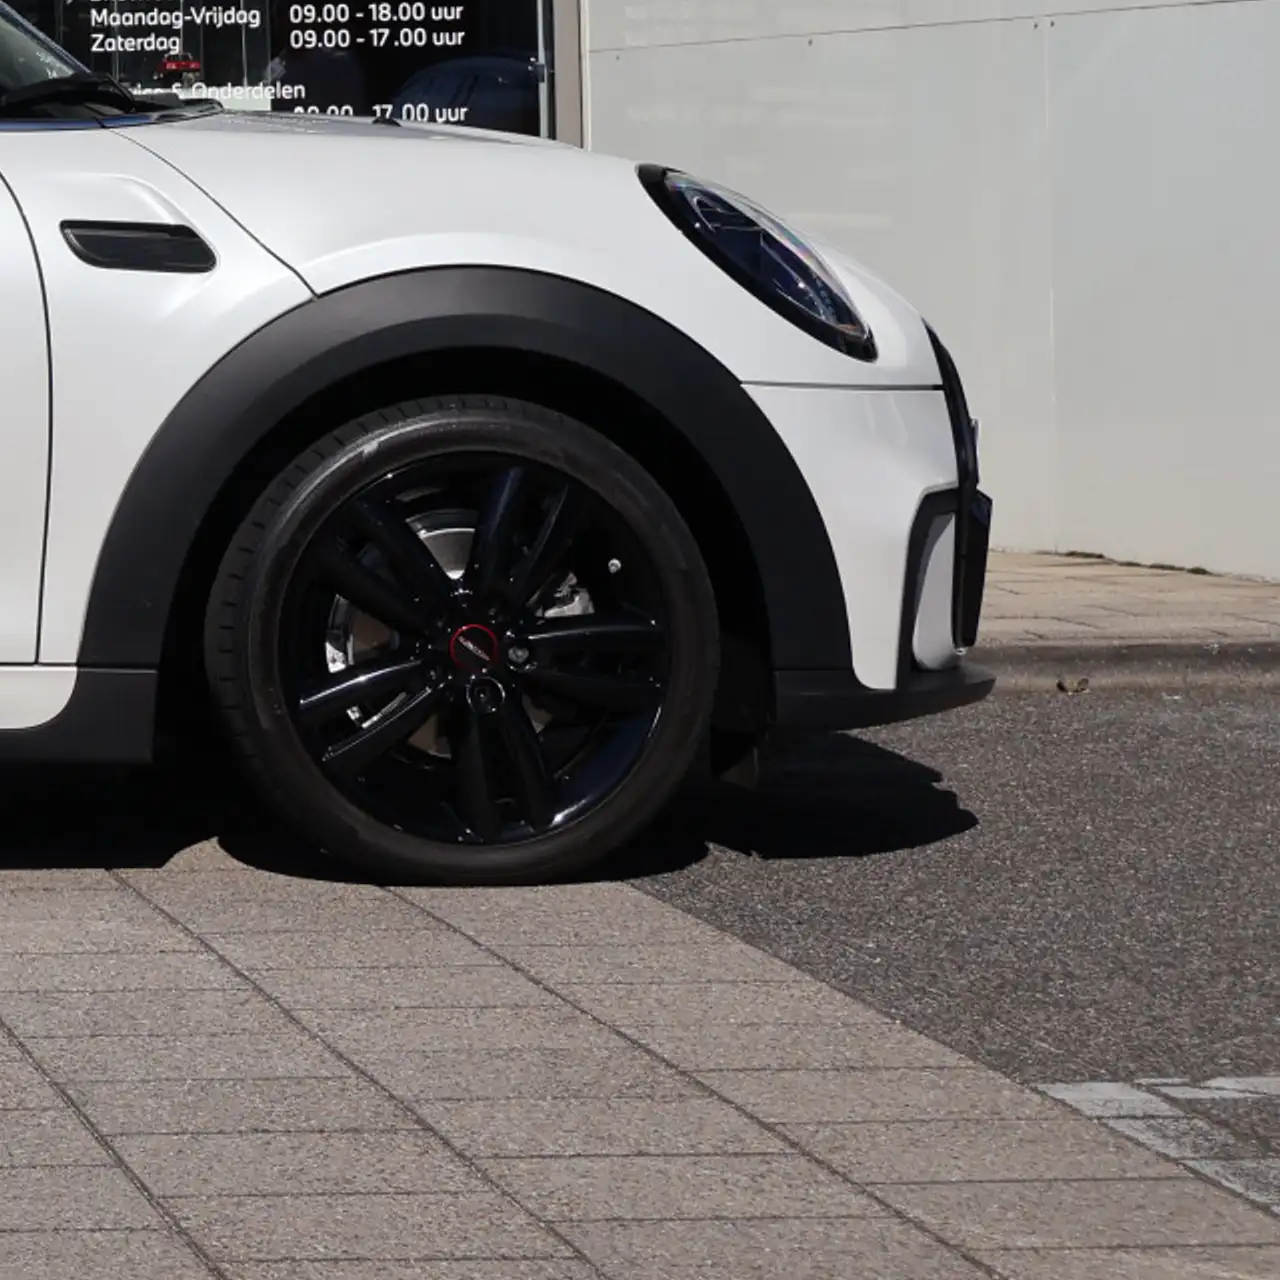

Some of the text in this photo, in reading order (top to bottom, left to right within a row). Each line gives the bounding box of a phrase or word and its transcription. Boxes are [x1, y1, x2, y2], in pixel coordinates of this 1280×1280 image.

[90, 6, 261, 29] Maandag-Vrijdag
[289, 3, 350, 24] 09.00
[368, 2, 426, 23] 18.00
[431, 5, 464, 21] uur
[91, 32, 181, 55] Zaterdag
[290, 29, 350, 50] 09.00
[432, 30, 465, 47] uur
[192, 80, 306, 101] Onderdelen
[434, 106, 468, 123] uur
